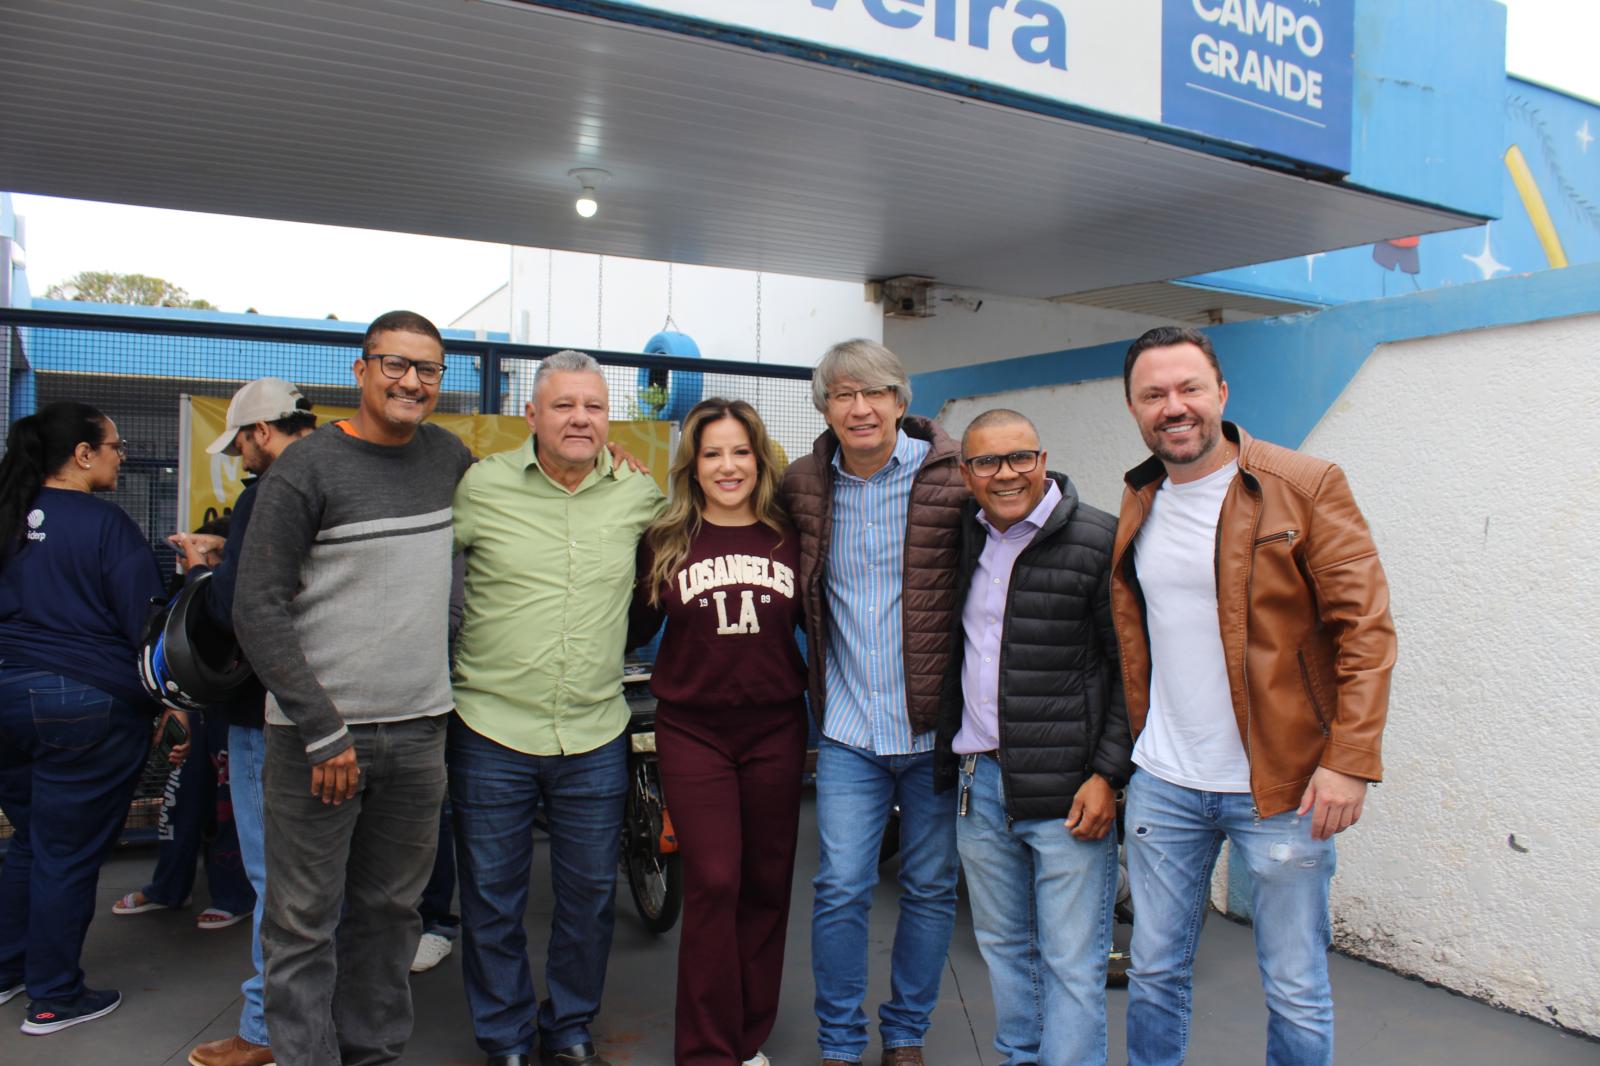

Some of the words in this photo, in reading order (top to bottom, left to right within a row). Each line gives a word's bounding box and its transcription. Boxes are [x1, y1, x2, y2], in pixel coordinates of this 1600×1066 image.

[1192, 0, 1323, 57] CAMPO
[1191, 33, 1323, 109] GRANDE
[712, 590, 760, 634] LA
